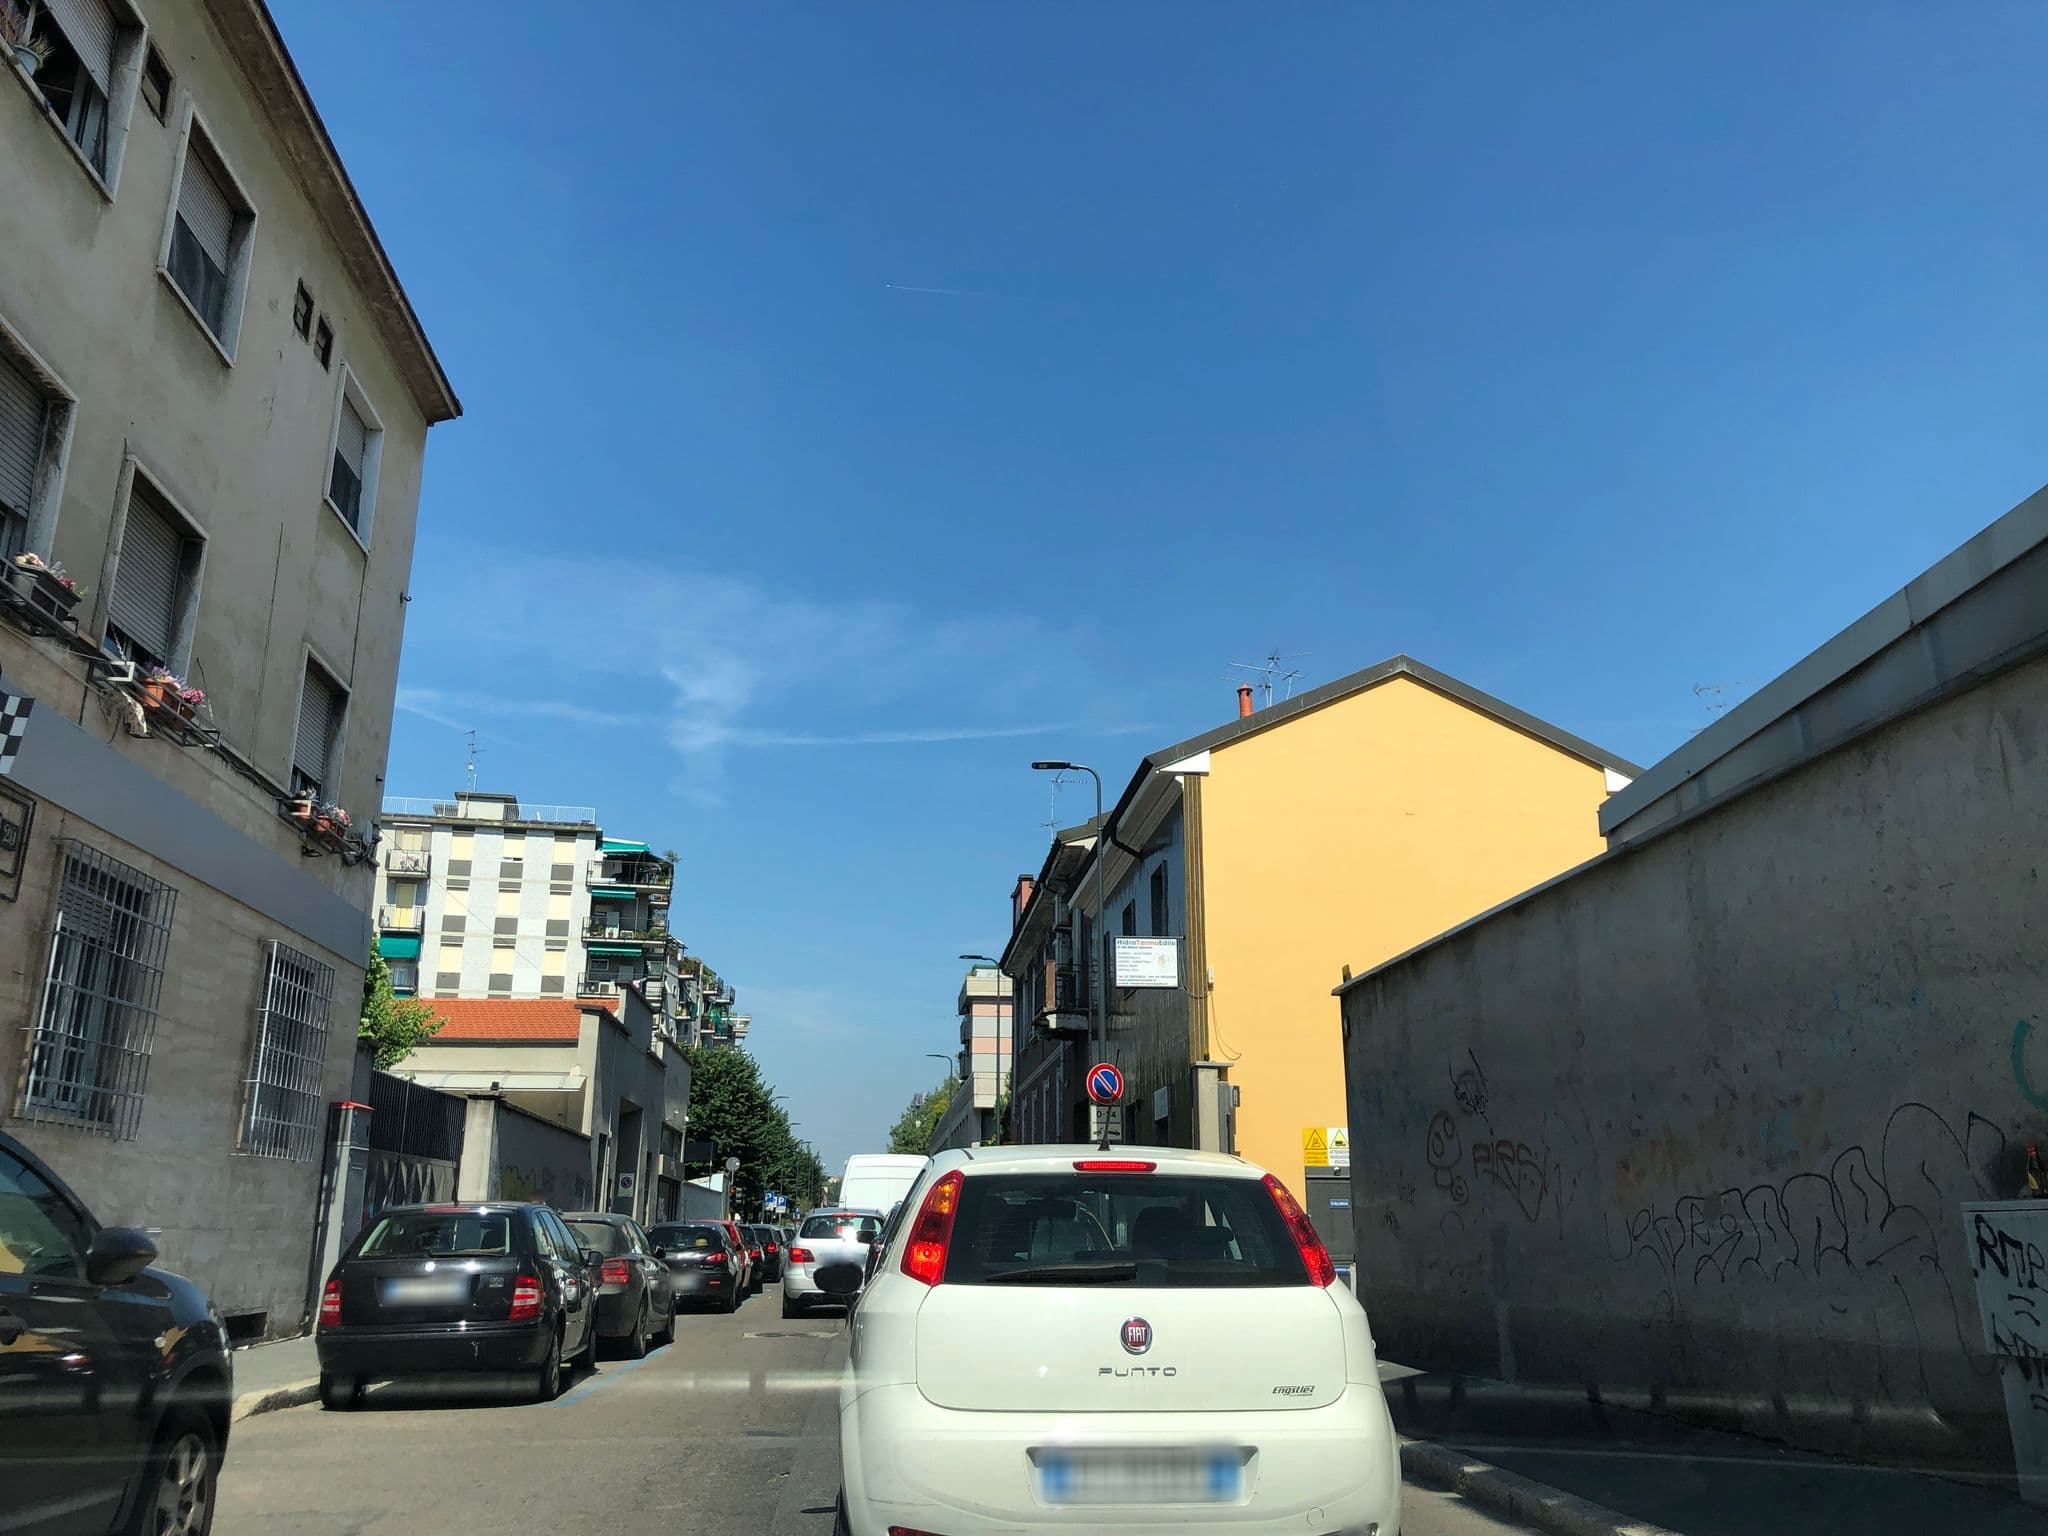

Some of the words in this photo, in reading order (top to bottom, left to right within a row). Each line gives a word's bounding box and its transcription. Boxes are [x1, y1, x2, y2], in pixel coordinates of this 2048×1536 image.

[765, 1193, 772, 1201] P
[778, 1197, 785, 1205] P
[1127, 1326, 1147, 1343] FIAT
[1098, 1366, 1177, 1377] PUNTO
